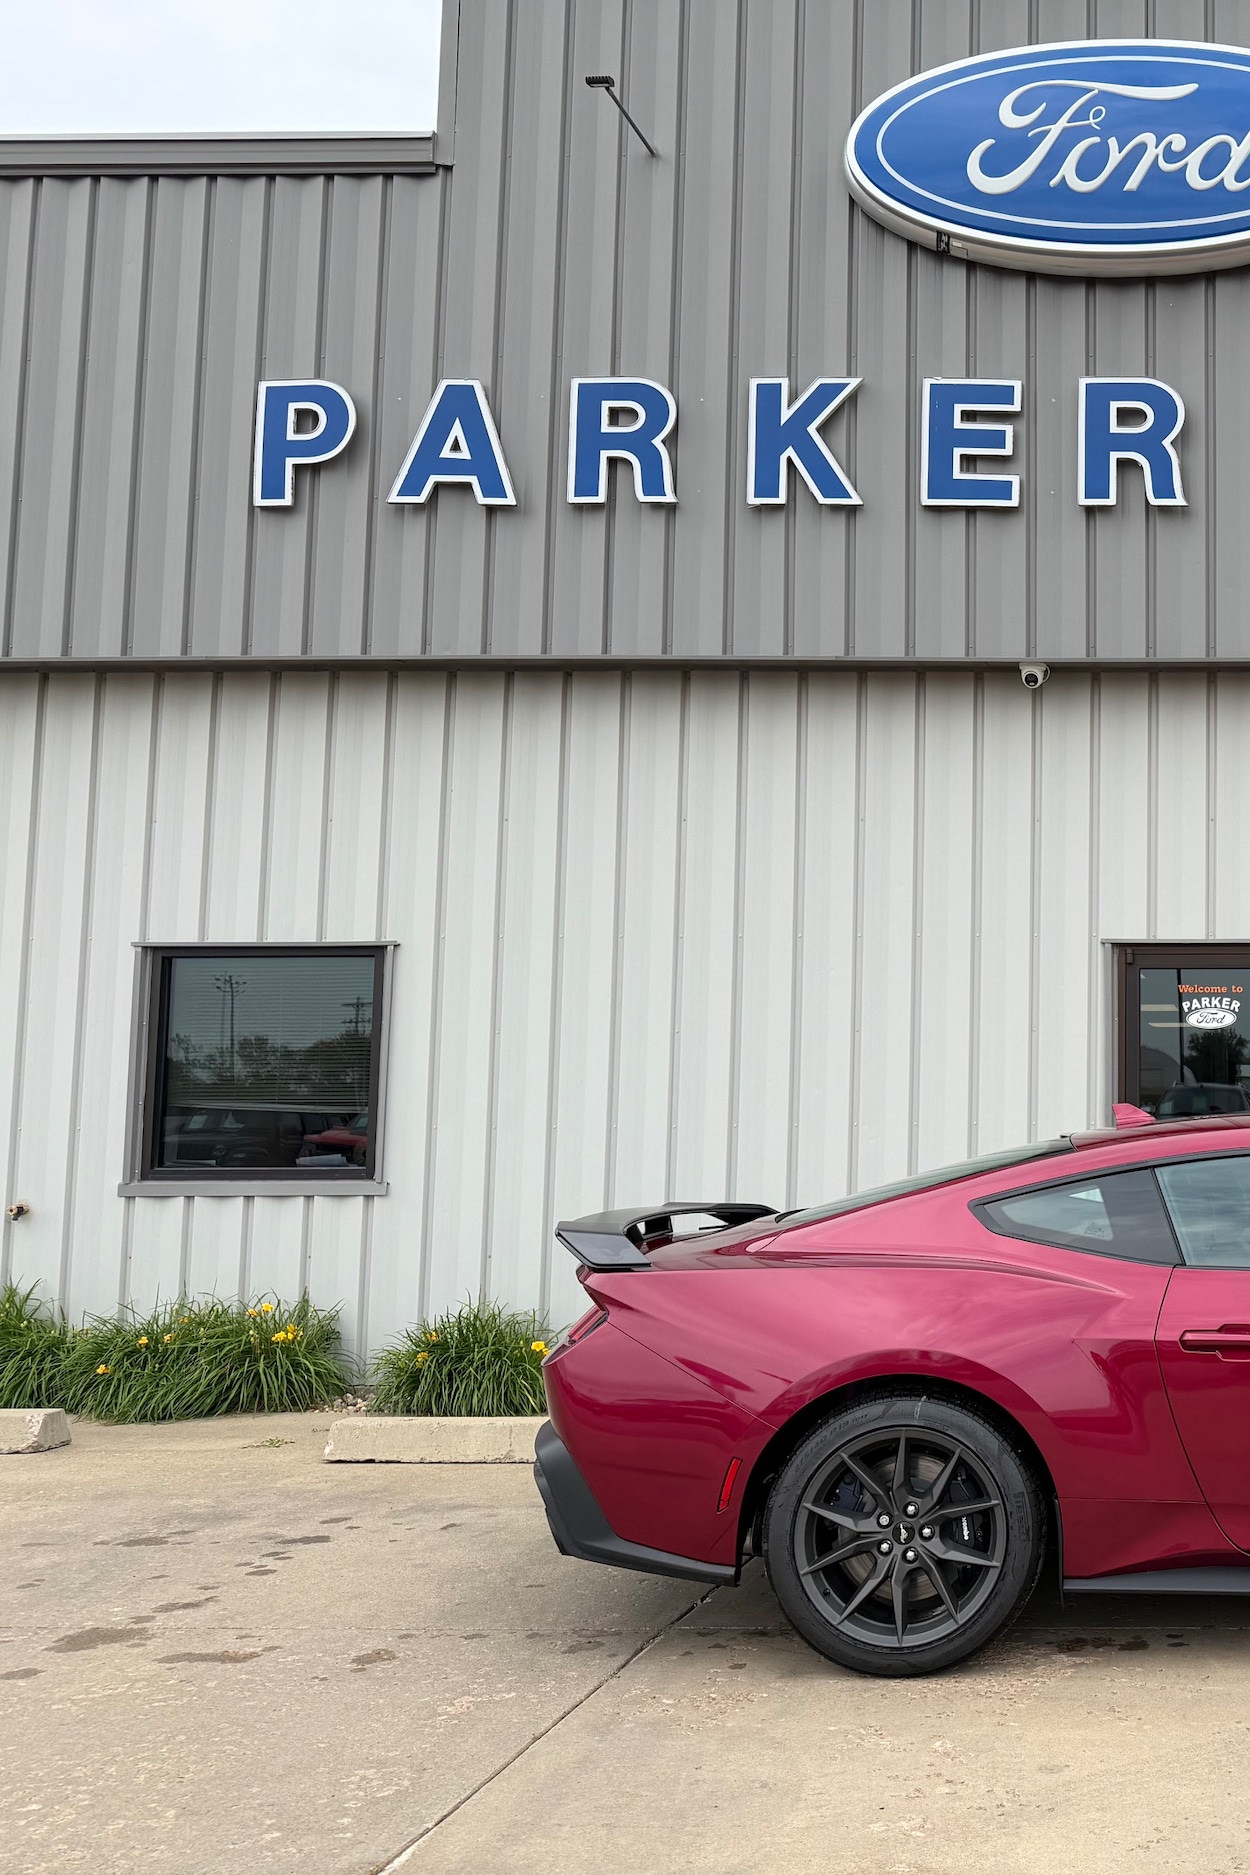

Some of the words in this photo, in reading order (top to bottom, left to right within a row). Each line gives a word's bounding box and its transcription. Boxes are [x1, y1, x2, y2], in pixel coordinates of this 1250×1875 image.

[253, 376, 1188, 507] PARKER
[1178, 984, 1228, 993] Welcome
[1231, 984, 1244, 993] to
[1182, 996, 1241, 1013] PARKER
[1196, 1011, 1226, 1024] Ford
